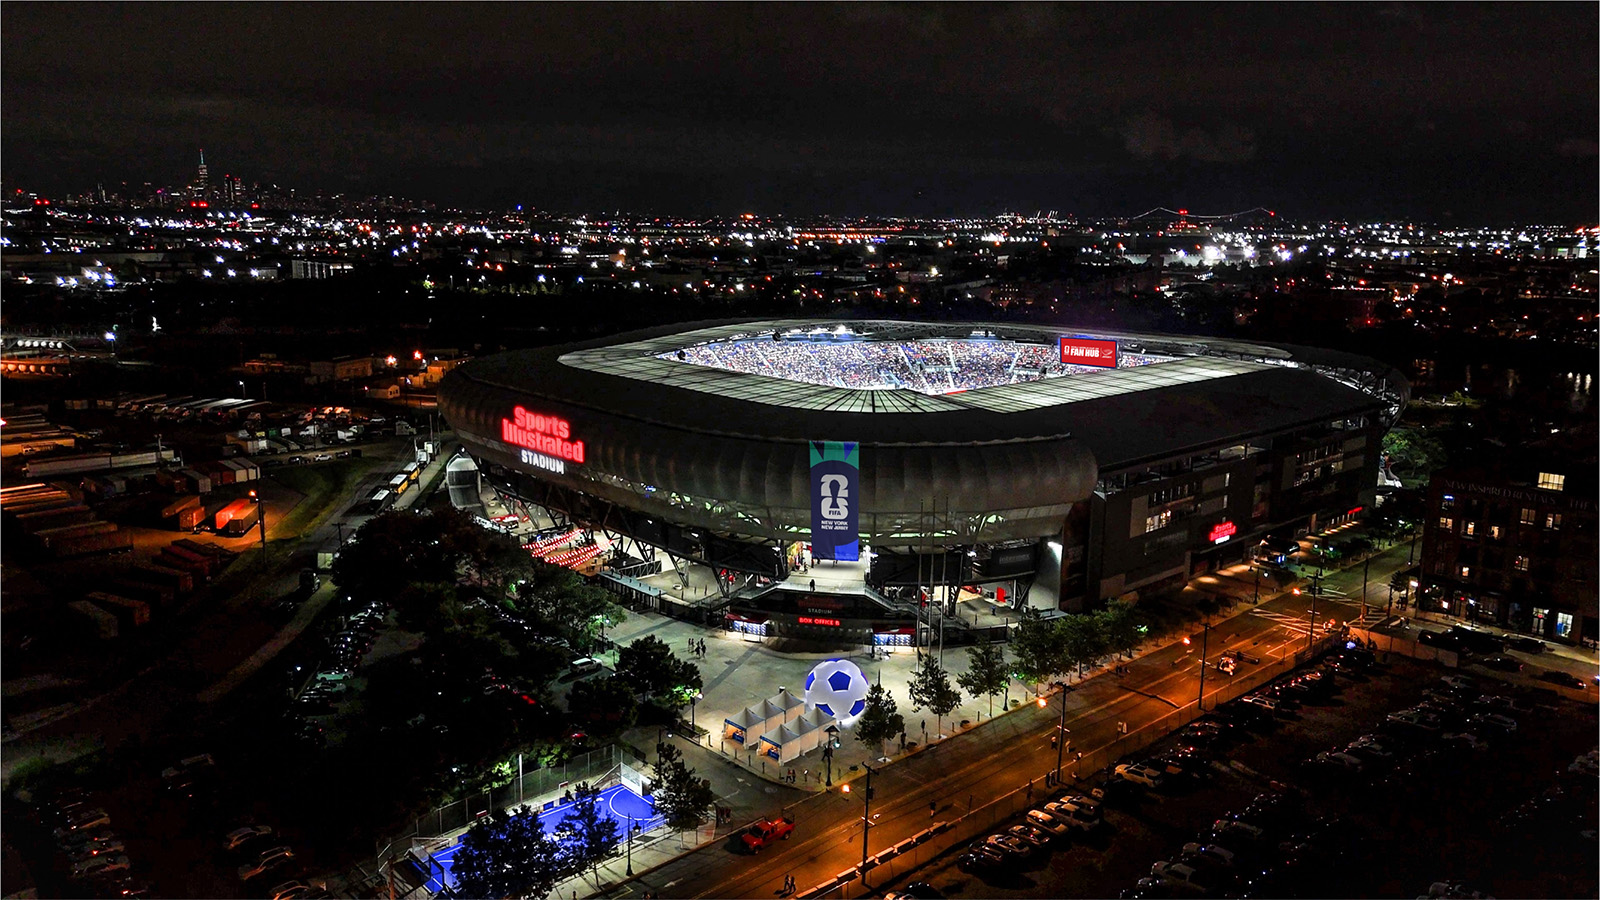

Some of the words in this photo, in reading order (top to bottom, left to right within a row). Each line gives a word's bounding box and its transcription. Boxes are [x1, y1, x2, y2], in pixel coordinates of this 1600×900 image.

[1070, 348, 1084, 357] FAN
[1084, 349, 1100, 358] HUB
[514, 405, 569, 439] Sports
[502, 418, 584, 463] Illustrated
[521, 449, 565, 475] STADIUM
[799, 616, 813, 624] BOX
[813, 617, 834, 626] OFFICE
